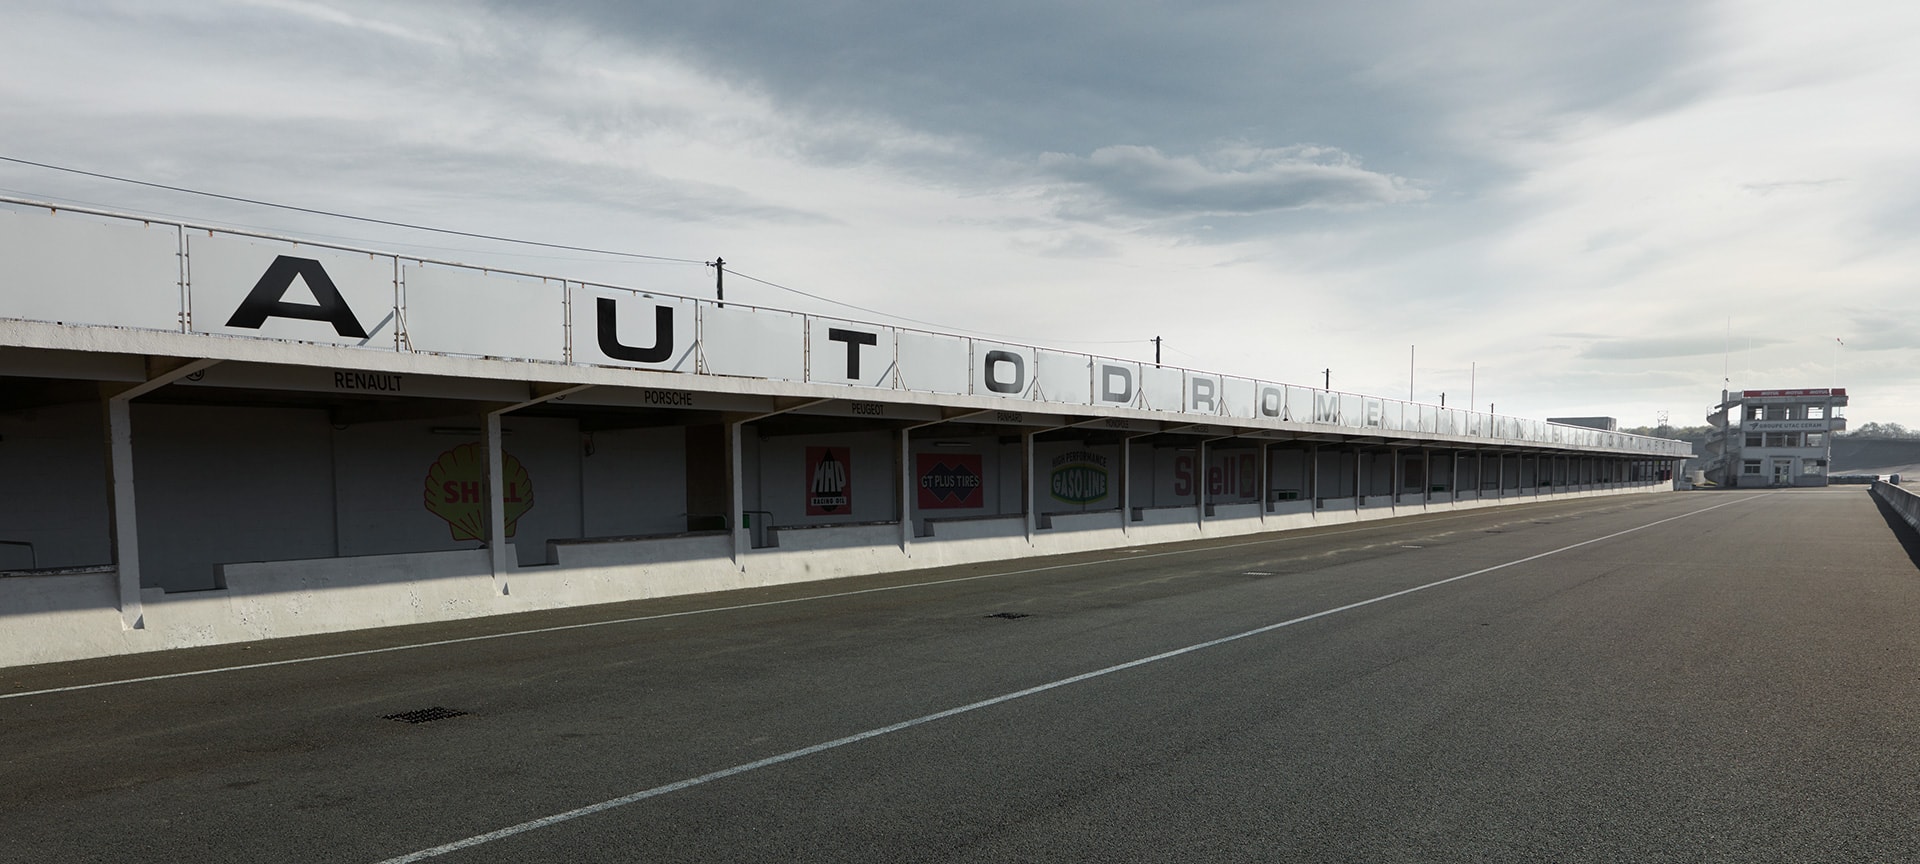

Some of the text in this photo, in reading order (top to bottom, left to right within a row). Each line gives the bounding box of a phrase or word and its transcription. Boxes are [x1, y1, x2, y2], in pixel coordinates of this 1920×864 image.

[334, 371, 402, 392] RENAULT
[644, 390, 692, 406] PORSCHE
[851, 403, 885, 416] PEUGEOT
[996, 412, 1023, 423] PANHARD
[1052, 450, 1107, 467] HIGH PERFORMANCE
[811, 460, 847, 493] MHP
[921, 475, 980, 488] GT PLUS TIRES
[1053, 469, 1106, 498] GASOLINE
[443, 480, 522, 503] SHL
